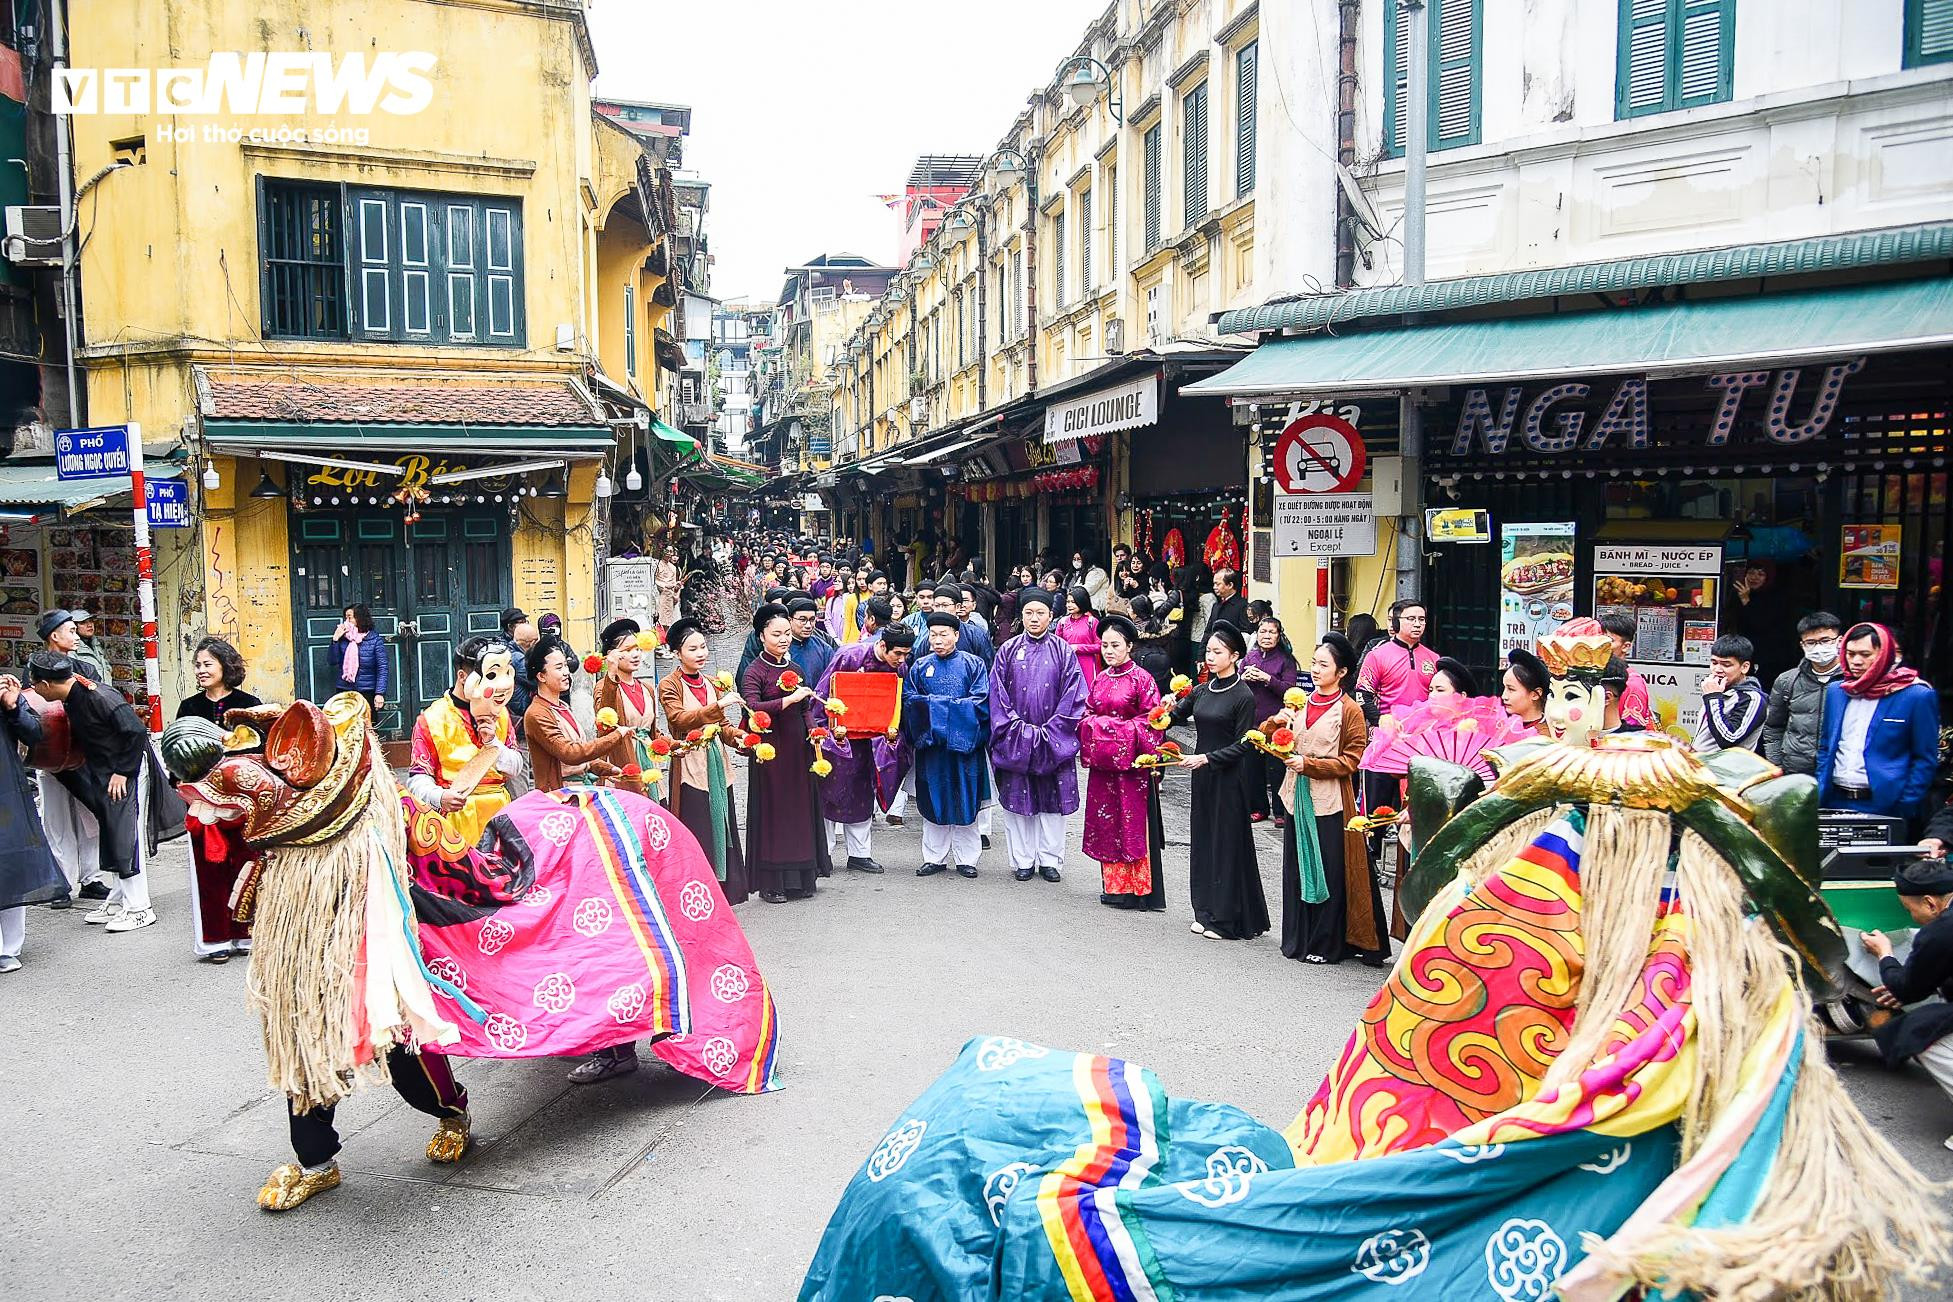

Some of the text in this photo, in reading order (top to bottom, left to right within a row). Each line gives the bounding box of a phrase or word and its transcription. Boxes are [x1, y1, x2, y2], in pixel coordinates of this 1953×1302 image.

[1705, 356, 1867, 447] TƯ
[1090, 391, 1143, 428] LOUNGE
[80, 433, 104, 449] PHỐ
[61, 452, 84, 472] LƯƠNG
[83, 452, 104, 474] NGỌC
[159, 485, 174, 498] PHỐ
[150, 502, 162, 522] TẠ
[1278, 501, 1287, 510] XE
[1287, 500, 1302, 510] QUÉT
[1341, 500, 1357, 511] HOẠT
[1333, 512, 1350, 523] HÀNG
[1307, 528, 1344, 541] NGOẠI LỆ
[1310, 542, 1342, 553] Except
[1600, 549, 1631, 560] BÁNH
[1698, 549, 1714, 561] ÉP
[1660, 562, 1681, 570] JUICE
[1507, 621, 1526, 635] TRÀ
[1502, 637, 1530, 651] BÁNH
